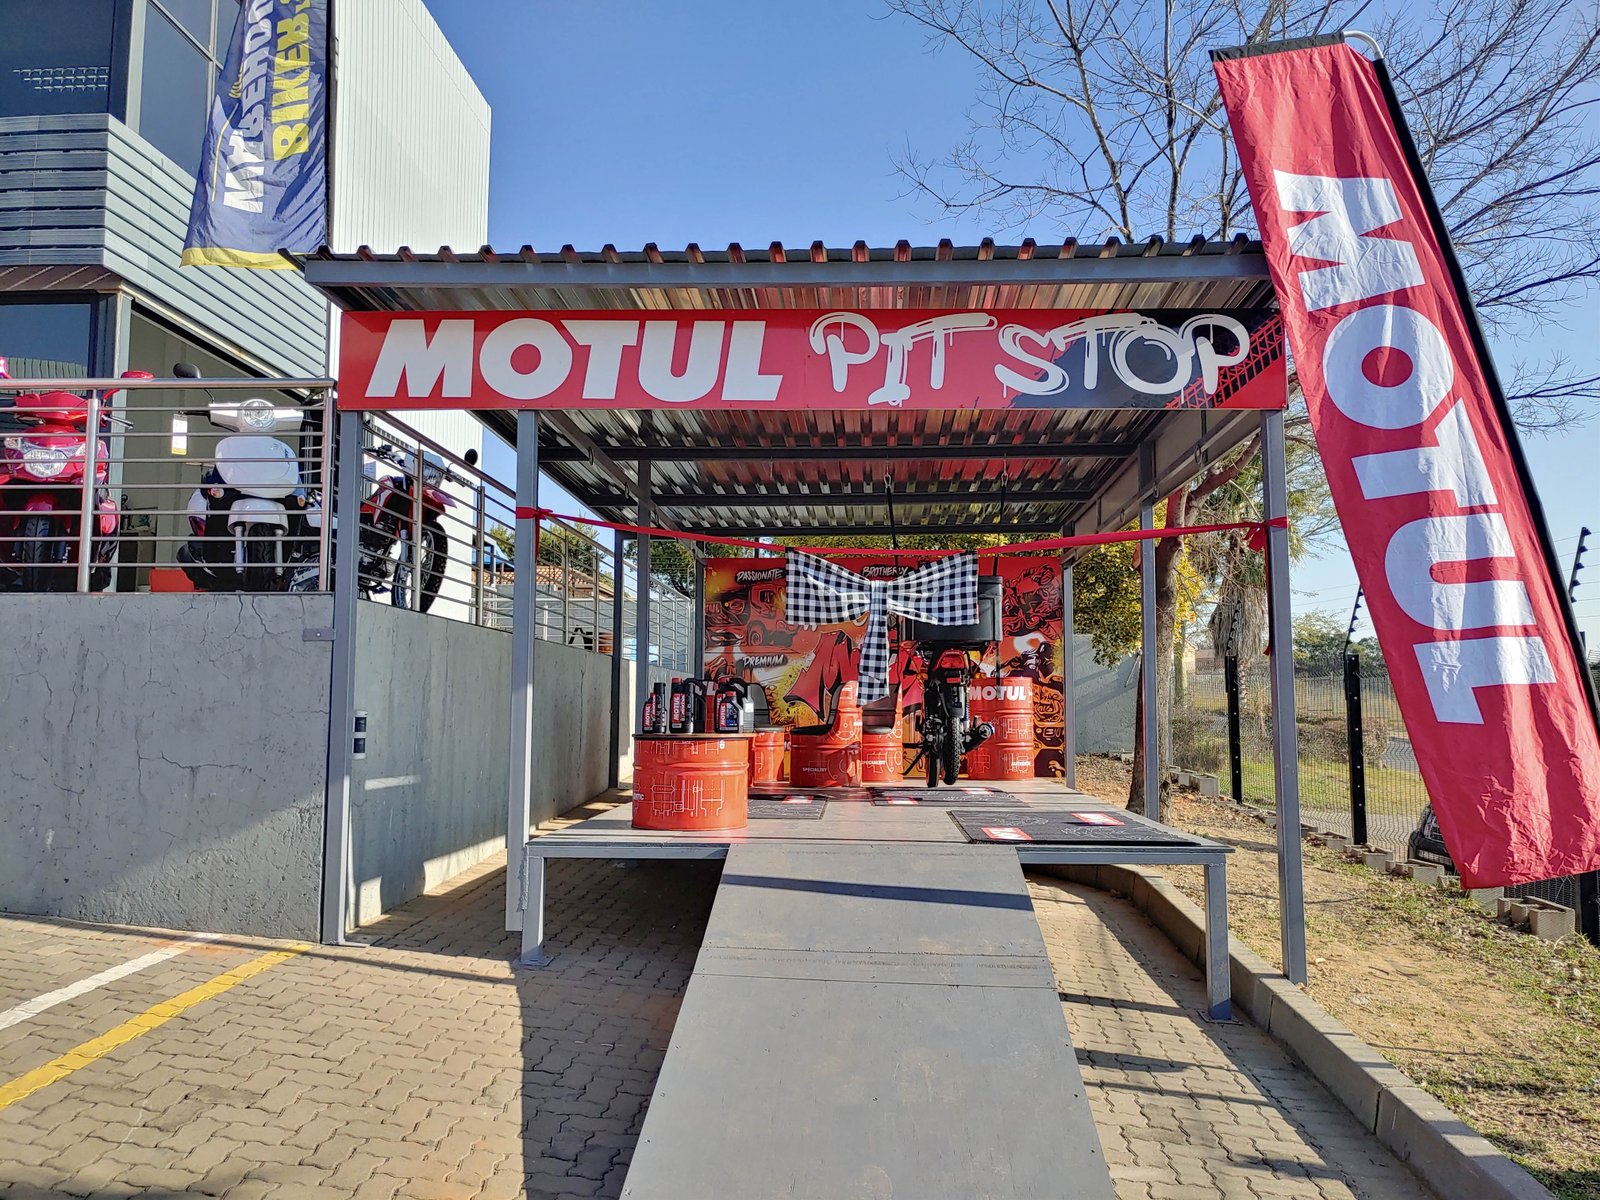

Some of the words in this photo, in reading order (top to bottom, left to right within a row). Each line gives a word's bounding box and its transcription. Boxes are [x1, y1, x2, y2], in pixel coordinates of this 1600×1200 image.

[364, 317, 784, 403] MOTUL
[809, 311, 999, 407] PIT
[994, 311, 1252, 402] STOP
[1273, 169, 1557, 725] MOTUL
[736, 568, 785, 583] PASSIONATE
[742, 653, 784, 668] PREMIUM
[969, 685, 1027, 701] MOTUL
